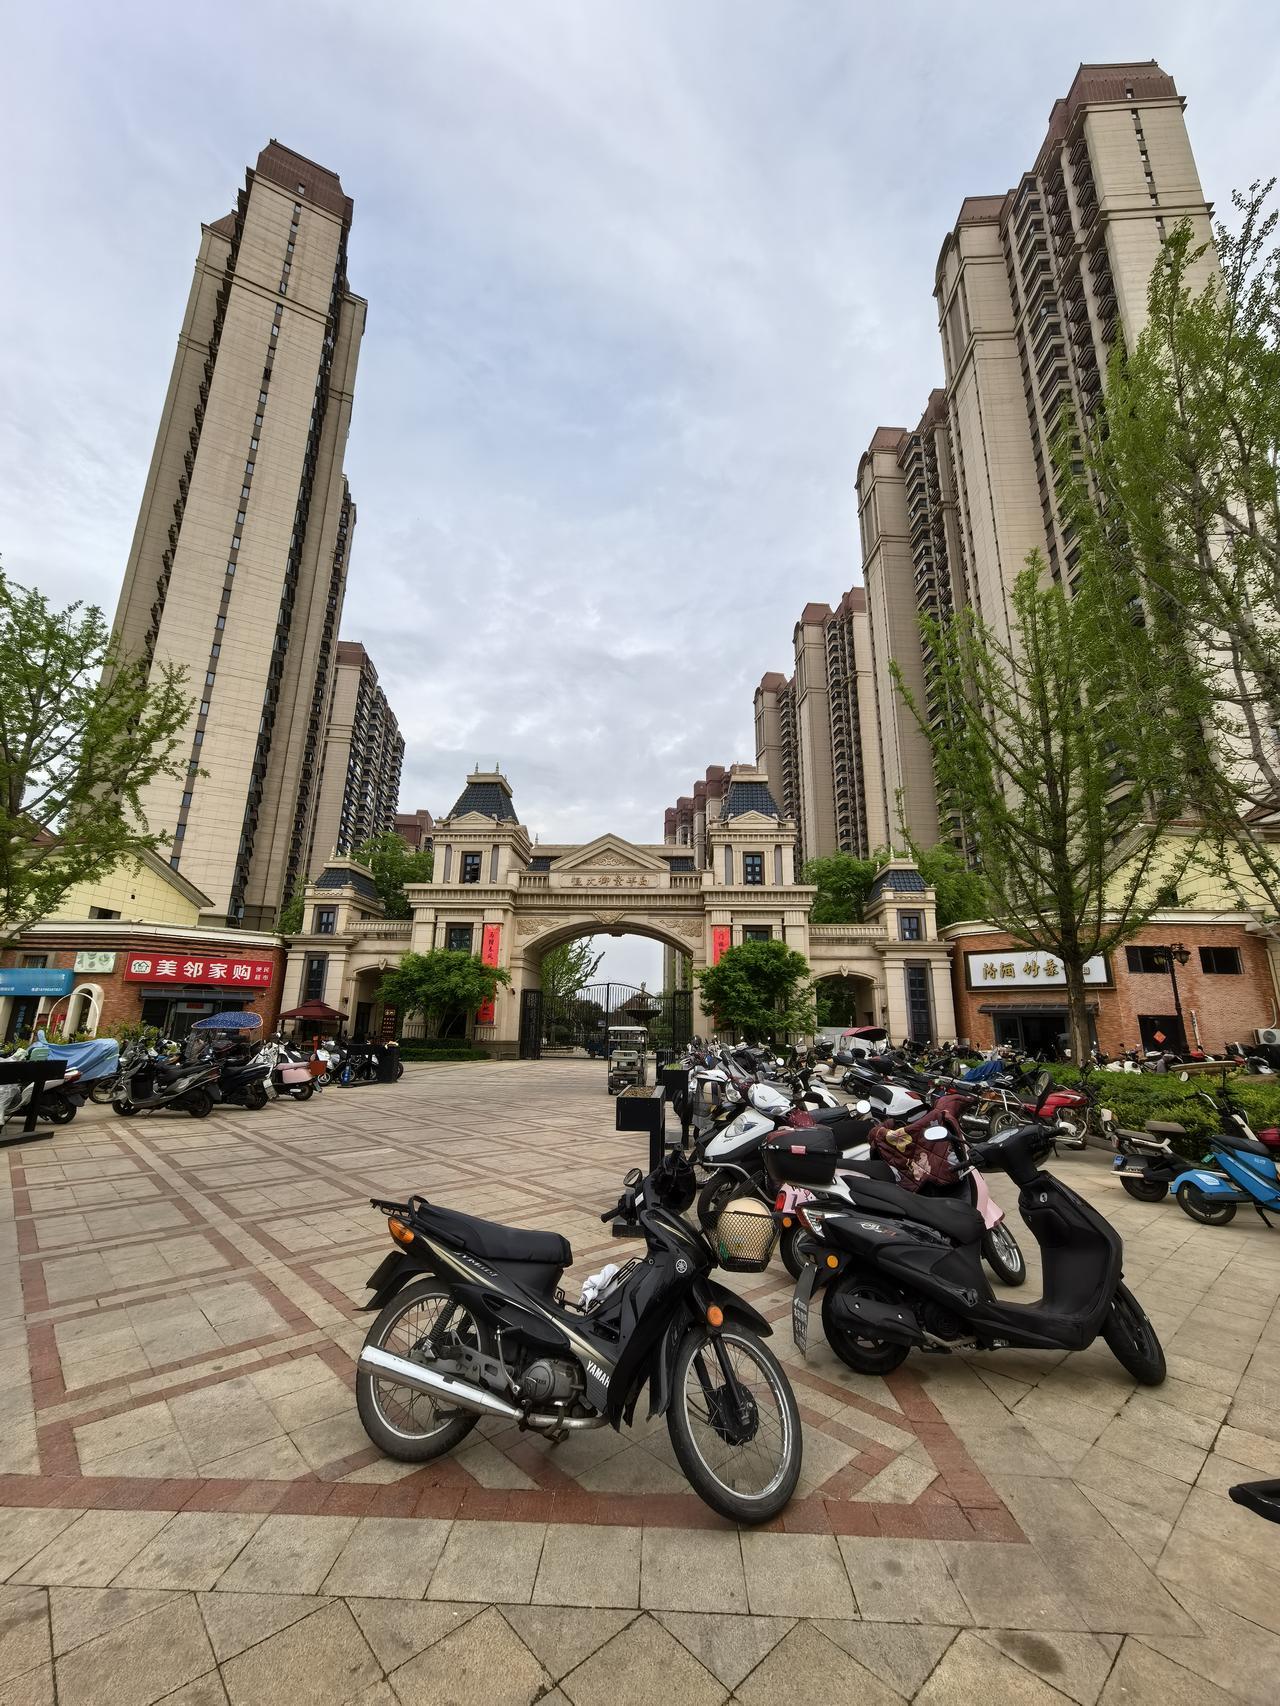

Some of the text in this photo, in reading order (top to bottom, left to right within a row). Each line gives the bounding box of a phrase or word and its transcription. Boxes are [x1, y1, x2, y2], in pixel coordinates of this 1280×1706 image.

[155, 960, 251, 980] 美邻家购
[586, 1359, 611, 1388] YAMAH
